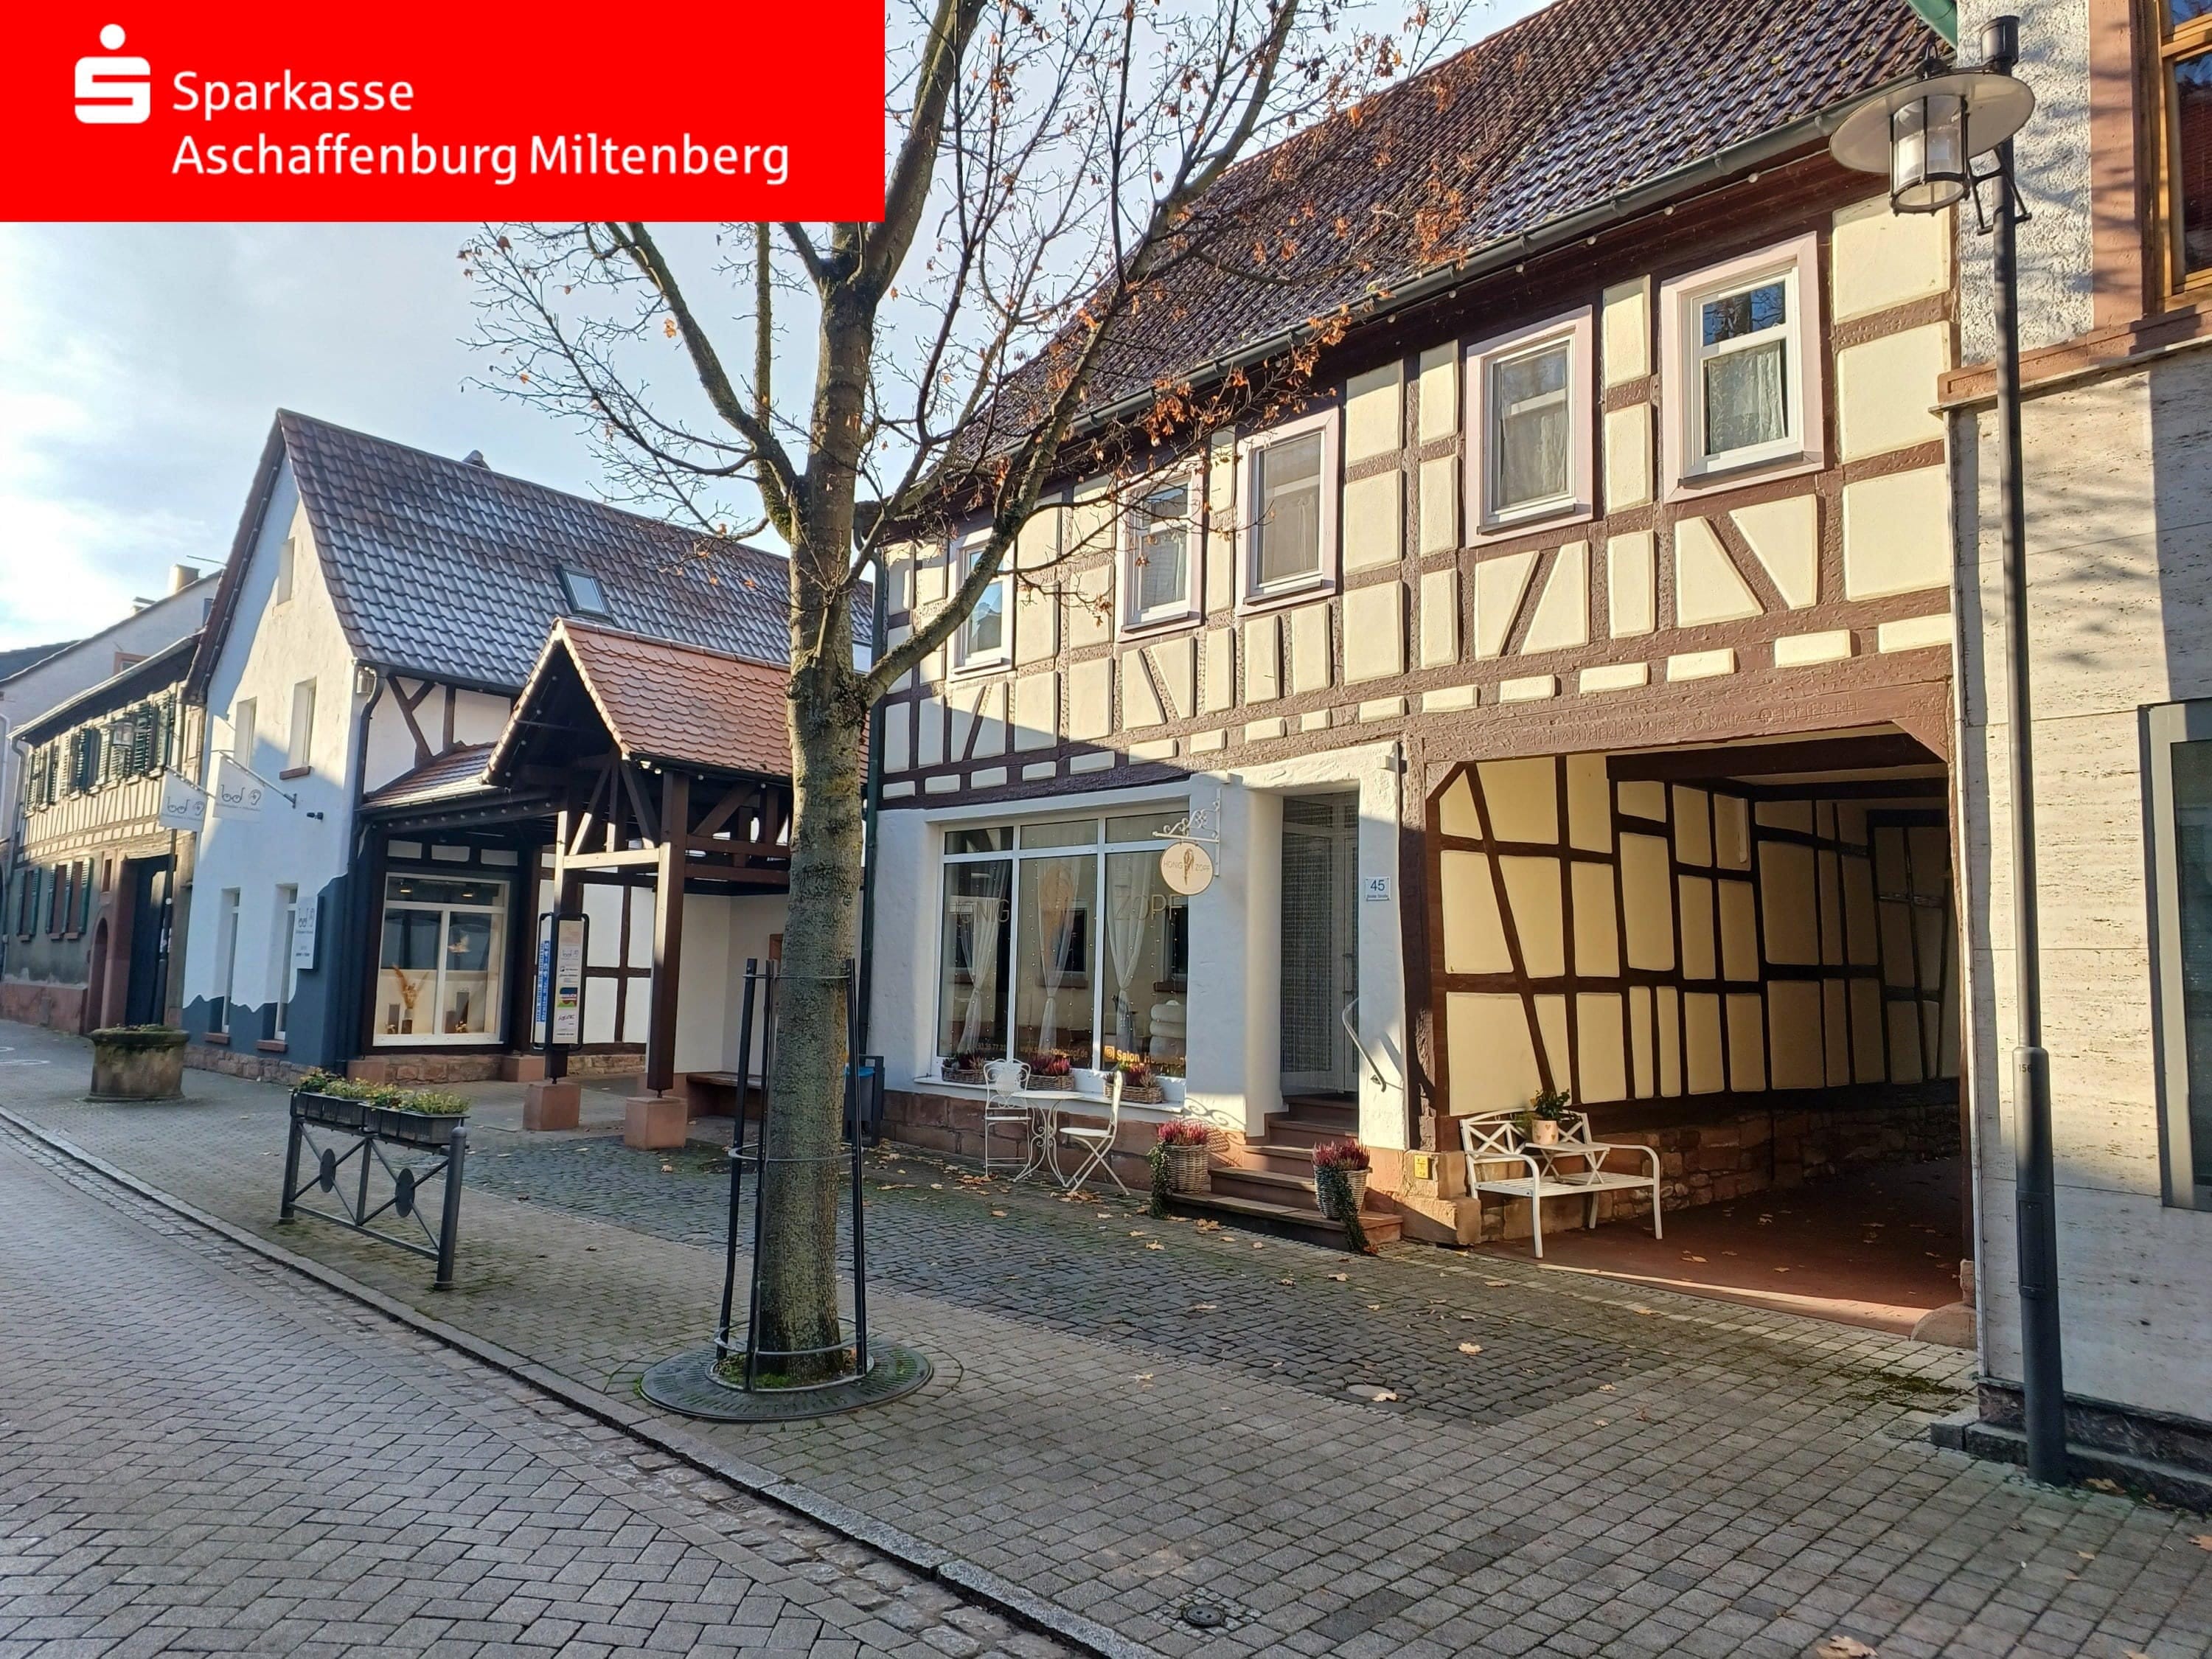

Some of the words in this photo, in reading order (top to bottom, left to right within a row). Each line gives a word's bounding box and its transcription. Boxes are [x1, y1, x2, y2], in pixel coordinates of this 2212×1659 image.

[1163, 860, 1183, 869] HONIG
[1195, 863, 1211, 872] ZOPF
[1370, 879, 1385, 891] 45
[1114, 894, 1183, 920] ZOPF
